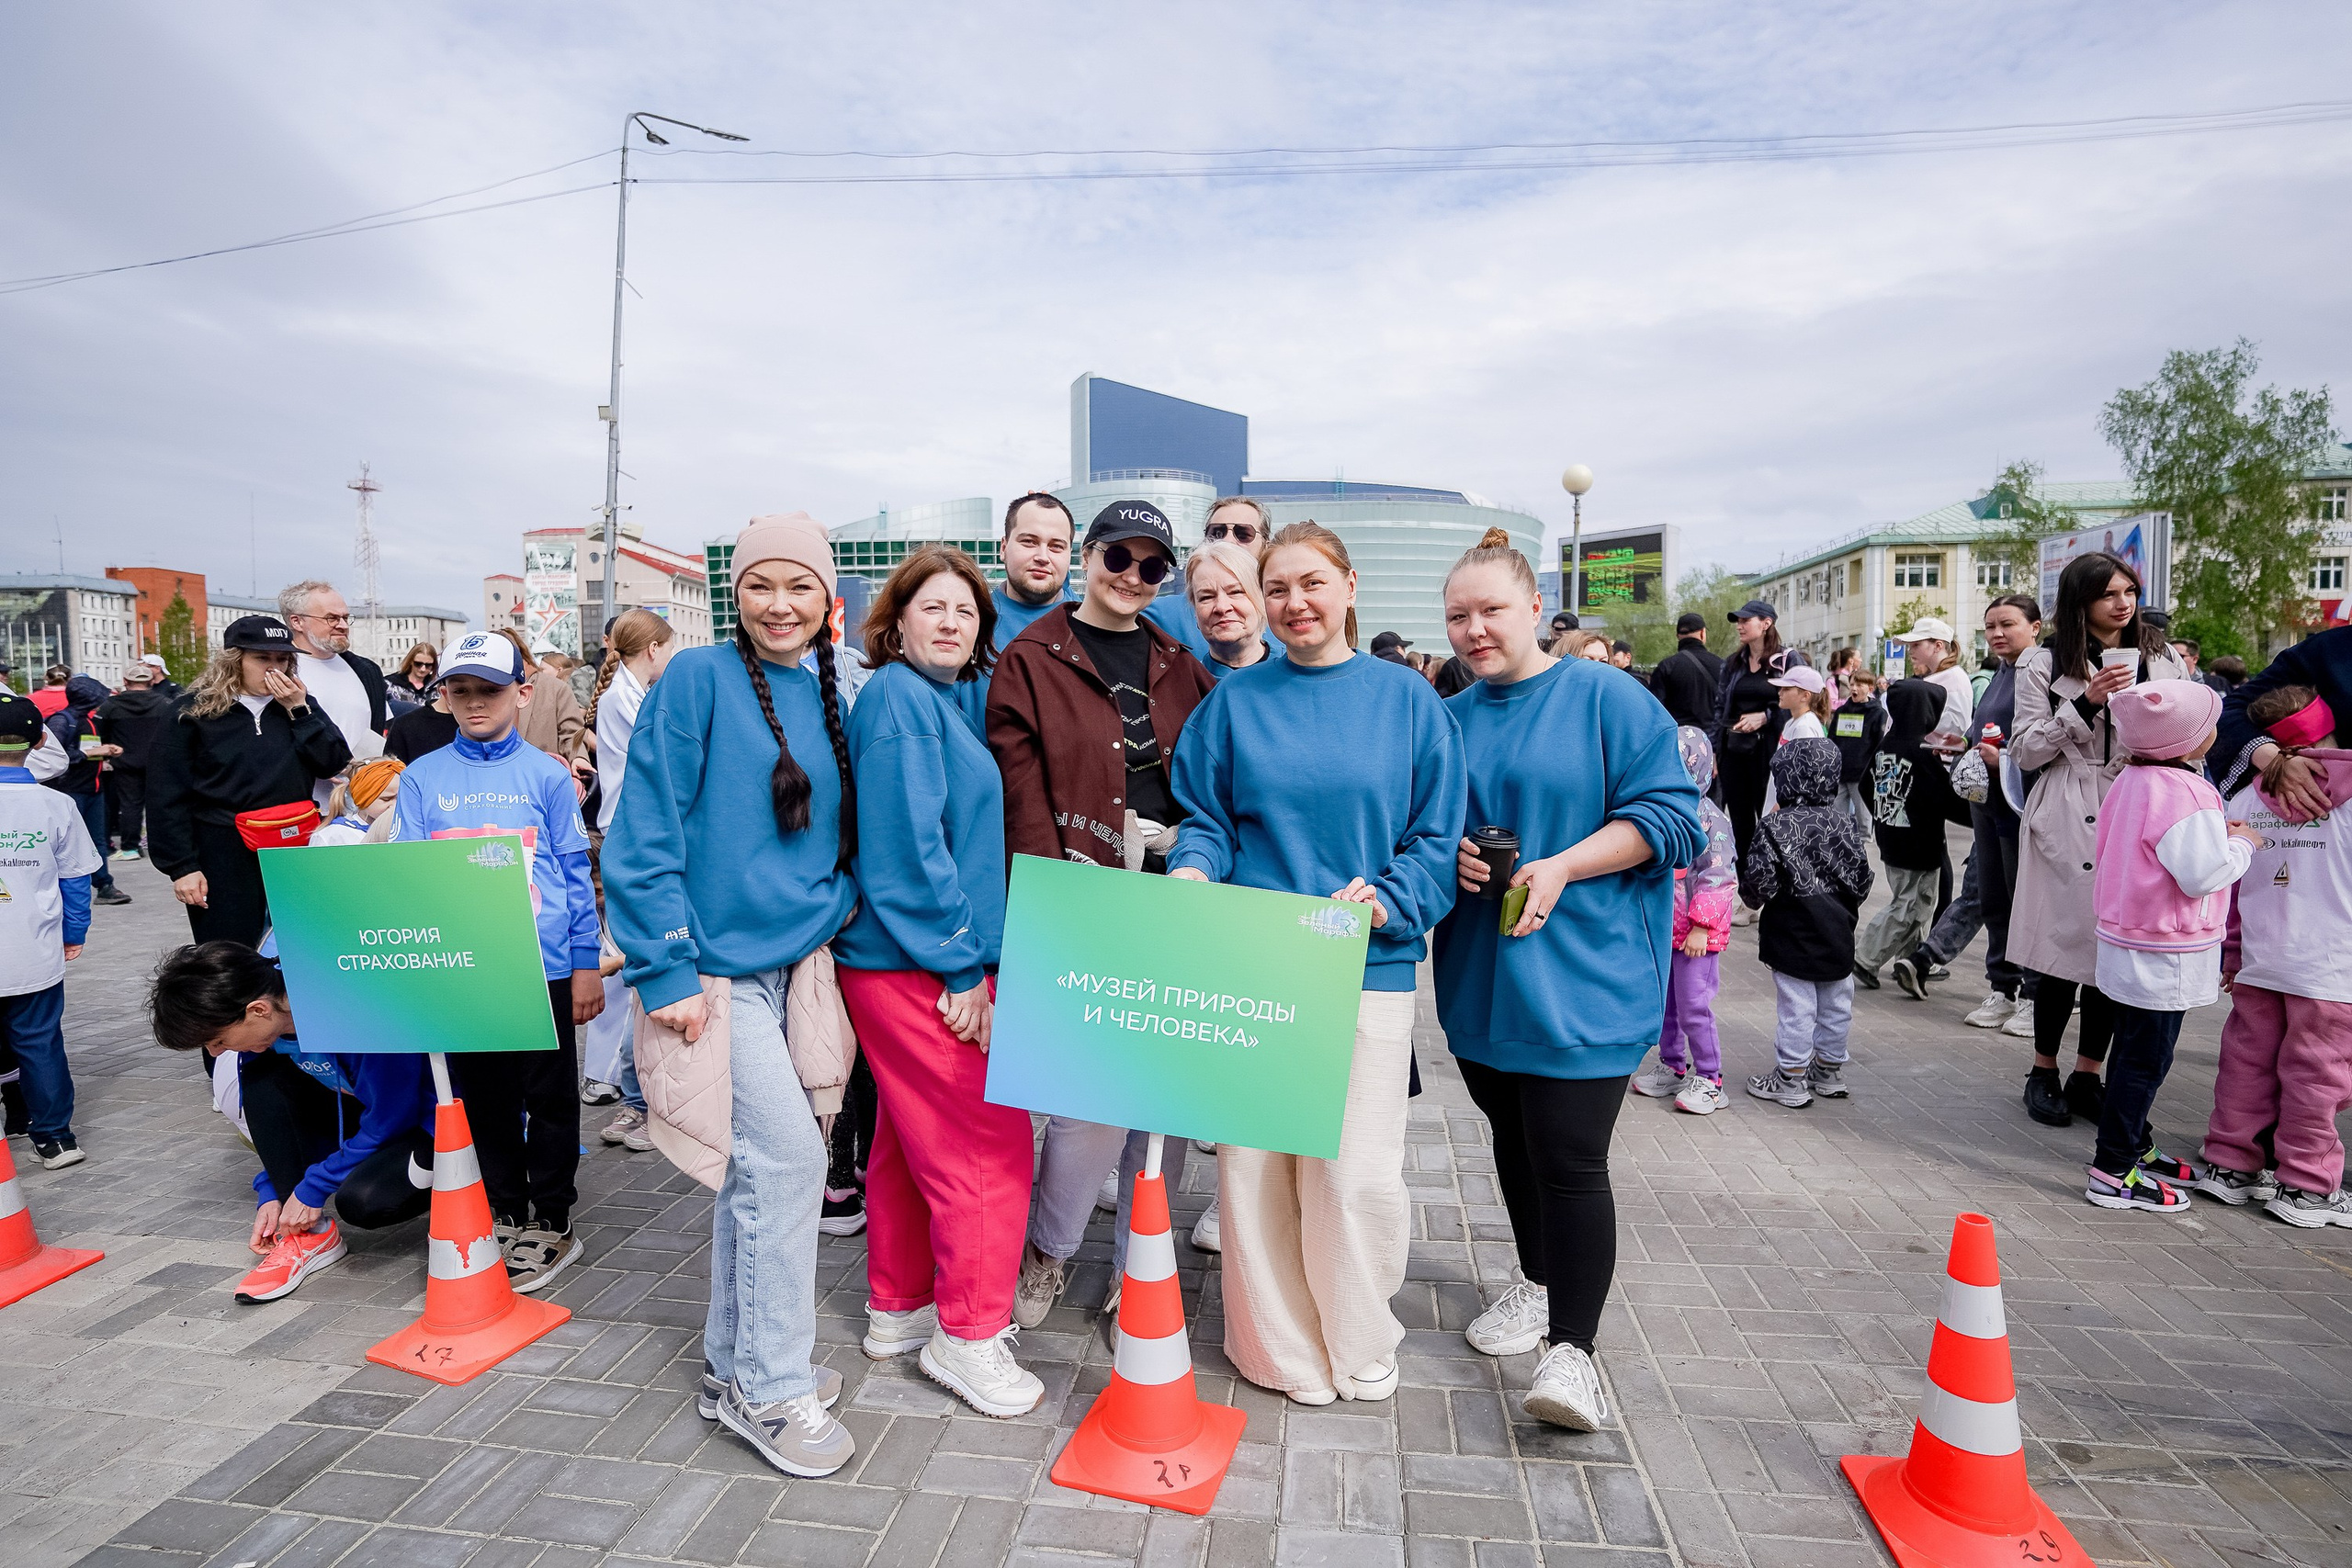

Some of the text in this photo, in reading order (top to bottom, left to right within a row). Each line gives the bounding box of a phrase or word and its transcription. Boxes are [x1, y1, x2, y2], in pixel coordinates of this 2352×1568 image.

[1118, 509, 1170, 536] YUGRA
[464, 792, 530, 805] ЮГОРИЯ
[464, 803, 513, 811] СТРАХОВАНИЕ
[1071, 814, 1087, 830] И
[358, 927, 441, 946] ЮГОРИЯ
[1313, 926, 1362, 939] Марафон
[336, 951, 476, 971] СТРАХОВАНИЕ
[1056, 970, 1296, 1024] «МУЗЕЙ ПРИРОДЫ
[1082, 1004, 1260, 1048] И ЧЕЛОВЕКА»
[2018, 1529, 2063, 1562] 29
